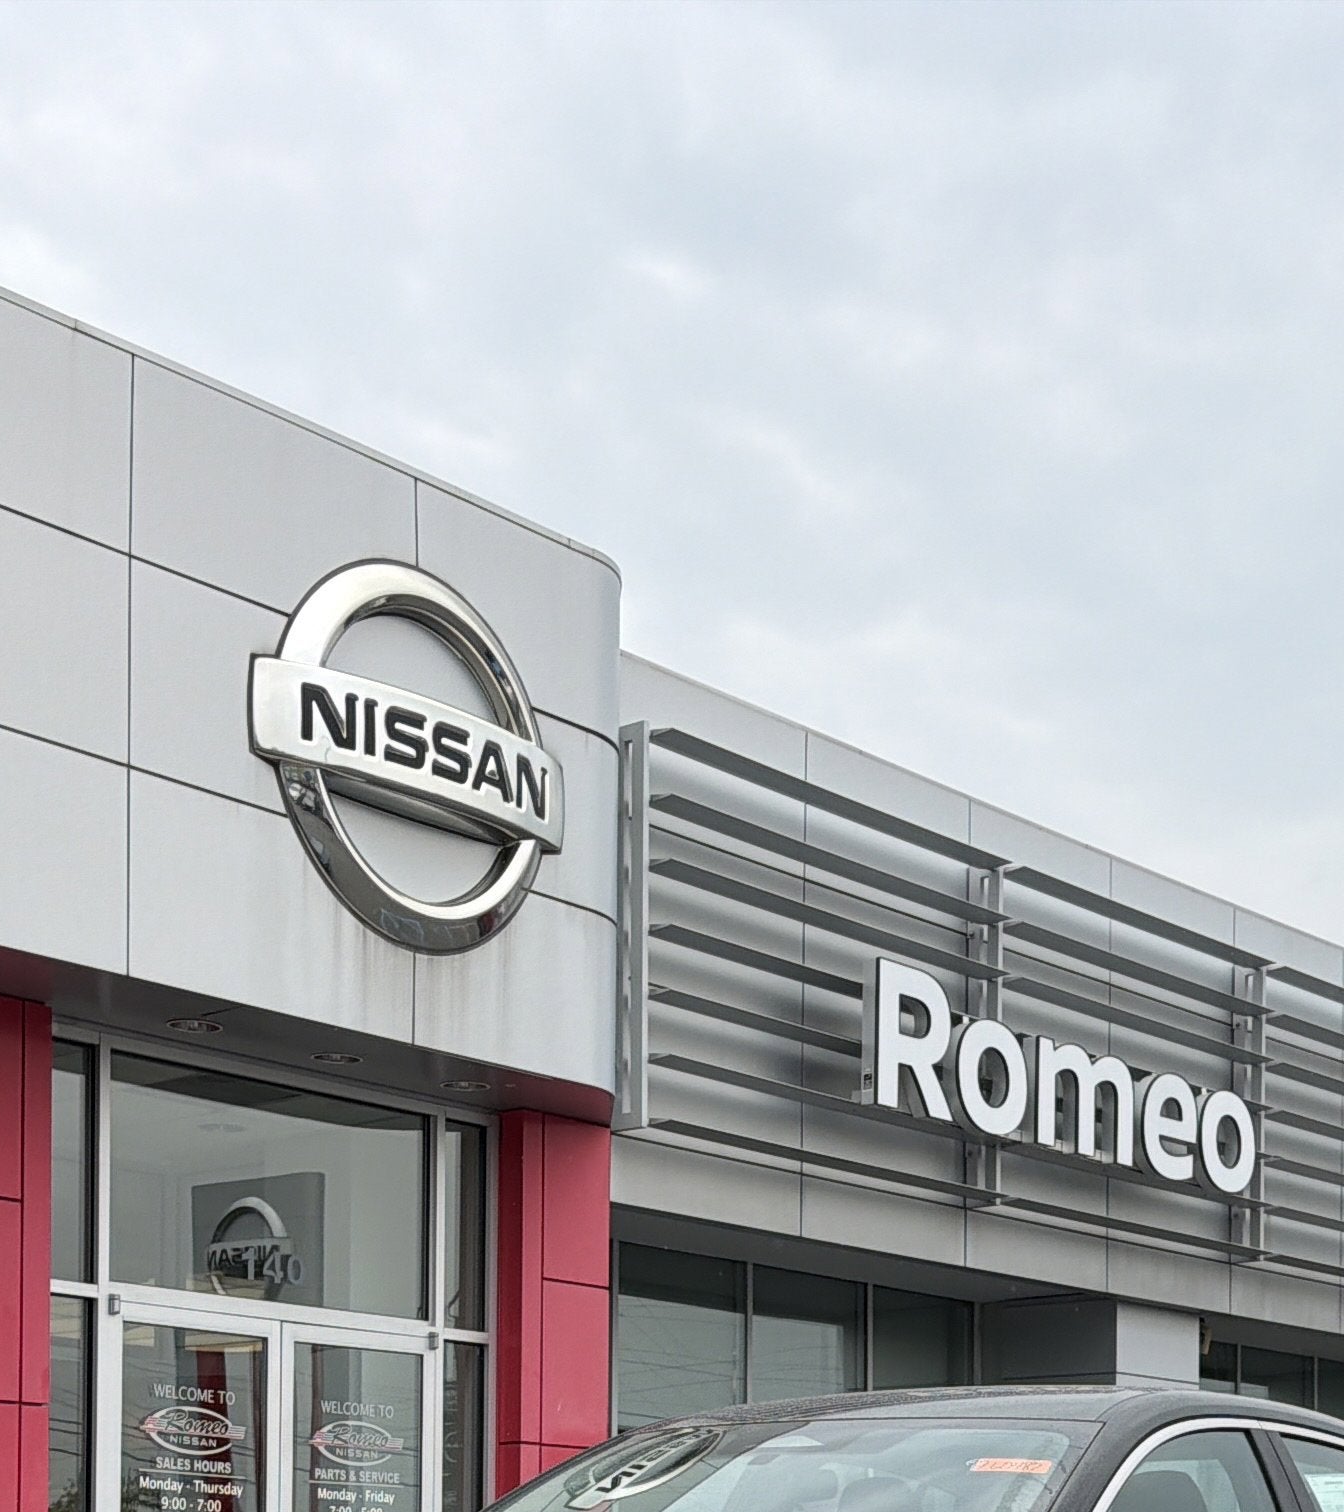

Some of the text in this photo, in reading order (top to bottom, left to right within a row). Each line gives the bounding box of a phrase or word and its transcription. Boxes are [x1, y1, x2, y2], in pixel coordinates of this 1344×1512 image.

[301, 682, 548, 820] NISSAN
[876, 956, 1256, 1194] Romeo
[153, 1383, 236, 1406] WELCOME TO
[320, 1400, 394, 1418] WELCOME TO
[159, 1409, 230, 1435] Romeo
[169, 1435, 217, 1447] NISSAN
[326, 1424, 389, 1448] Romeo
[336, 1447, 378, 1459] NISSAN
[156, 1456, 232, 1474] SALES HOURS
[314, 1468, 400, 1484] PARTS & SERVICE
[139, 1475, 184, 1494] Monday
[193, 1479, 244, 1498] Thursday
[160, 1496, 187, 1511] 9:00
[197, 1498, 222, 1512] 7:00
[317, 1487, 357, 1503] Monday
[365, 1489, 395, 1506] Friday
